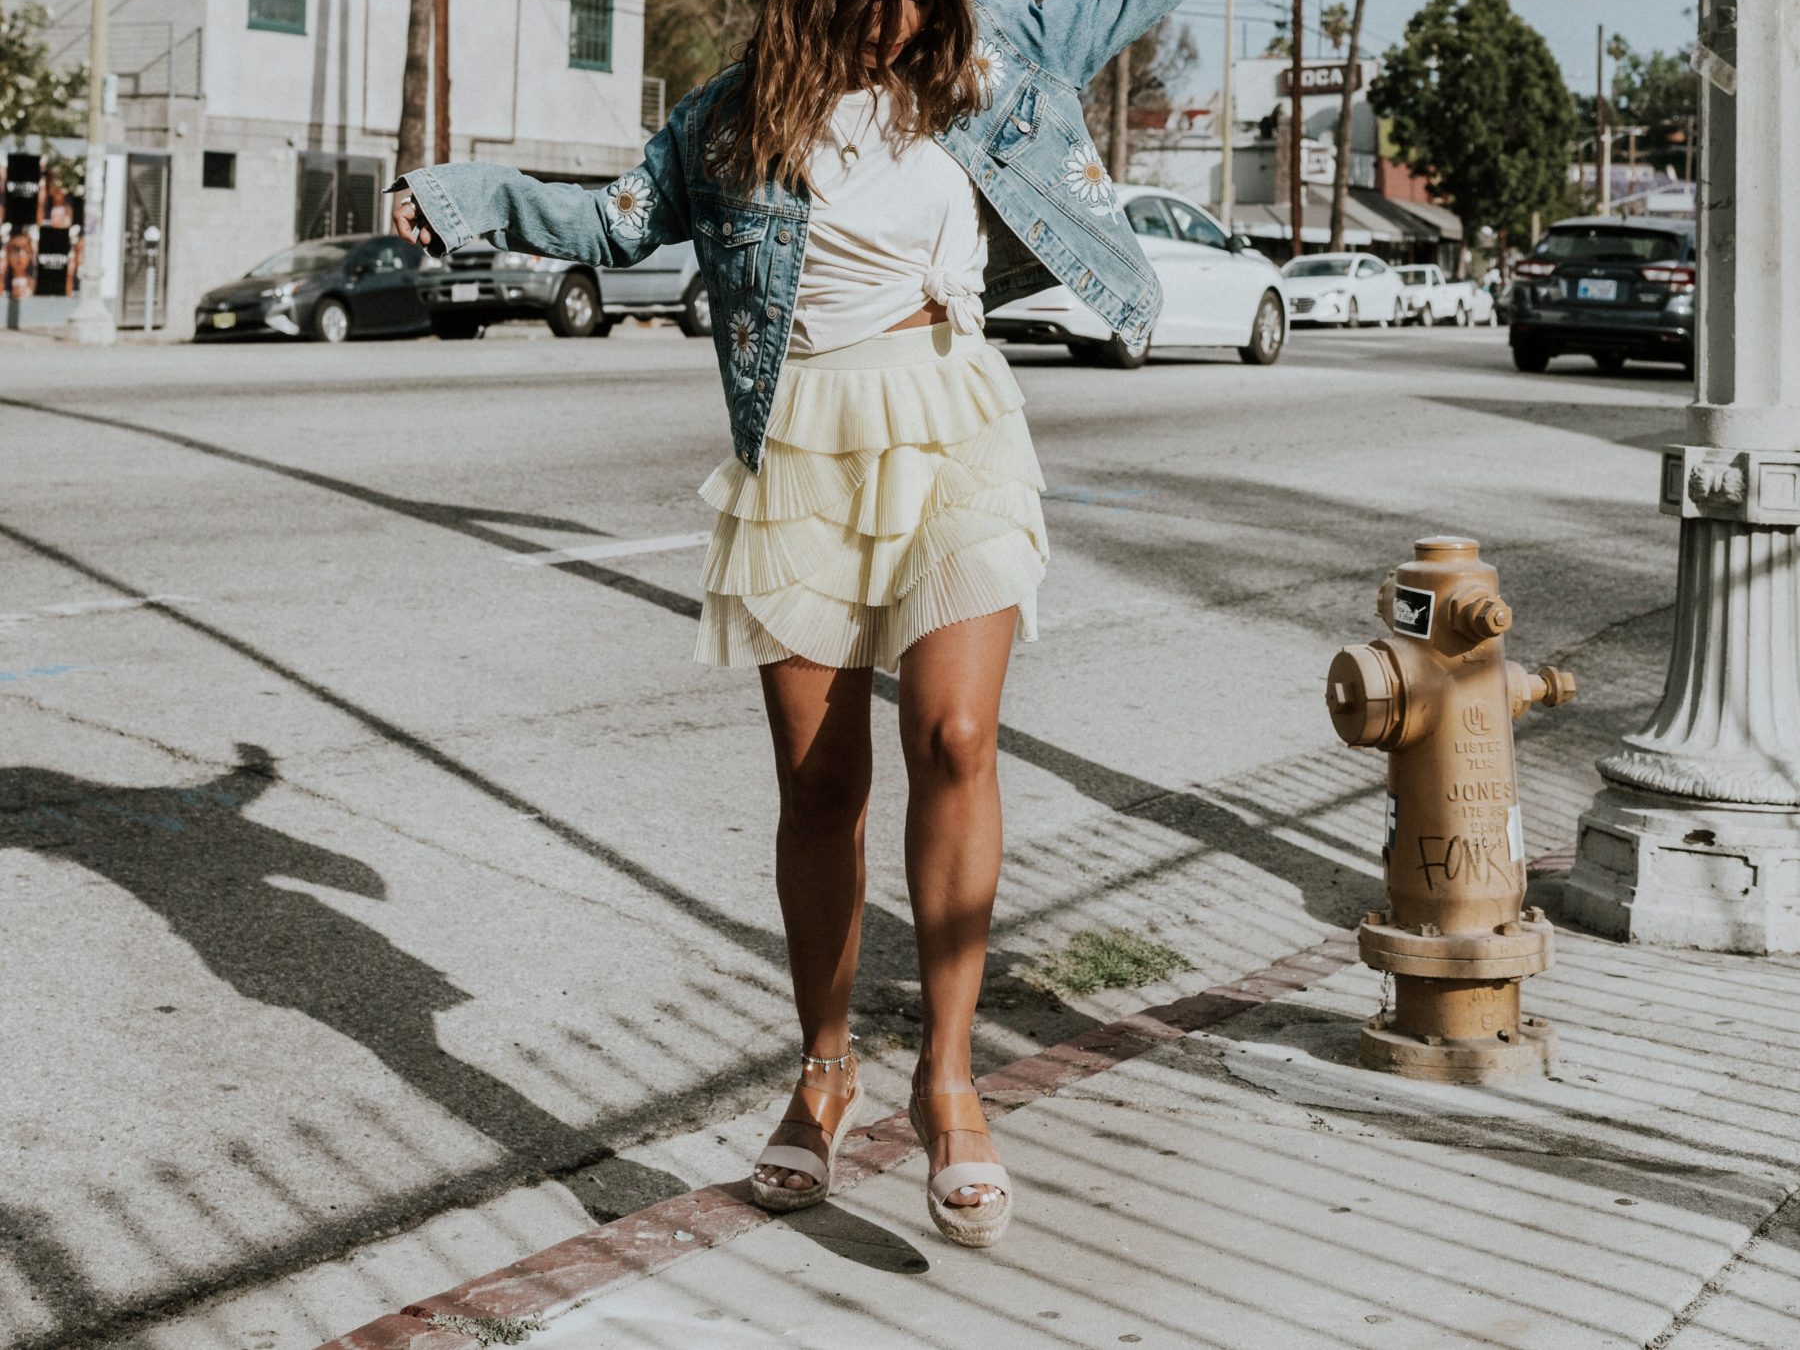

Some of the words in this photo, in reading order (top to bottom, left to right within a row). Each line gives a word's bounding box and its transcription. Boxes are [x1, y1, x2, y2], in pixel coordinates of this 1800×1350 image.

[1287, 68, 1345, 87] OCA
[1467, 703, 1493, 732] UL
[1446, 780, 1513, 802] JONES
